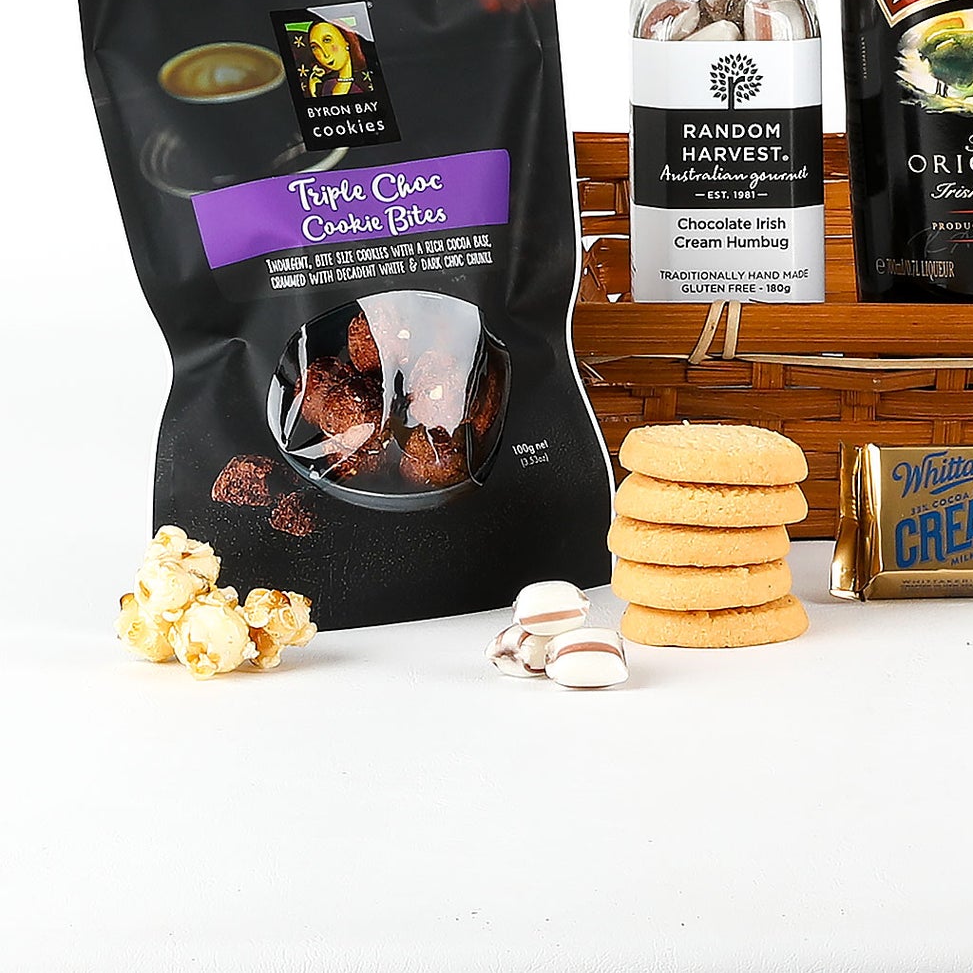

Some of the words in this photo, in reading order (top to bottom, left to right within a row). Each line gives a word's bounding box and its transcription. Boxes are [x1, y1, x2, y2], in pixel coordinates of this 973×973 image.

[307, 105, 351, 118] BYRON
[355, 101, 378, 114] BAY
[313, 120, 385, 137] cookies
[683, 123, 781, 139] RANDOM
[660, 163, 748, 182] Australian
[750, 165, 809, 190] gourmet
[288, 177, 366, 211] Triple
[371, 173, 443, 202] Choc
[707, 190, 730, 200] EST.
[733, 190, 756, 200] 1981
[302, 214, 383, 242] Cookie
[384, 205, 447, 236] Bites
[677, 217, 752, 230] Chocolate
[756, 217, 786, 230] Irish
[674, 236, 722, 249] Cream
[727, 235, 789, 250] Humbug
[315, 253, 333, 268] BITE
[356, 247, 389, 262] COOKIES
[391, 243, 414, 257] WITH
[417, 242, 423, 255] A
[425, 240, 444, 253] RICH
[446, 237, 471, 251] COCOA
[271, 273, 306, 289] CRAMMED
[309, 270, 334, 285] WITH
[336, 264, 376, 281] DECADENT
[379, 261, 406, 275] WHITE
[409, 258, 418, 272] &
[421, 257, 442, 270] DARK
[444, 254, 464, 268] CHOC
[660, 270, 745, 281] TRADITIONALLY
[749, 270, 780, 280] HAND
[783, 268, 809, 280] MADE
[921, 260, 955, 281] LIQUEUR
[681, 283, 725, 293] GLUTEN
[728, 283, 756, 293] FREE
[766, 283, 791, 294] 180g
[512, 443, 535, 455] 100g
[932, 493, 970, 508] COCOA
